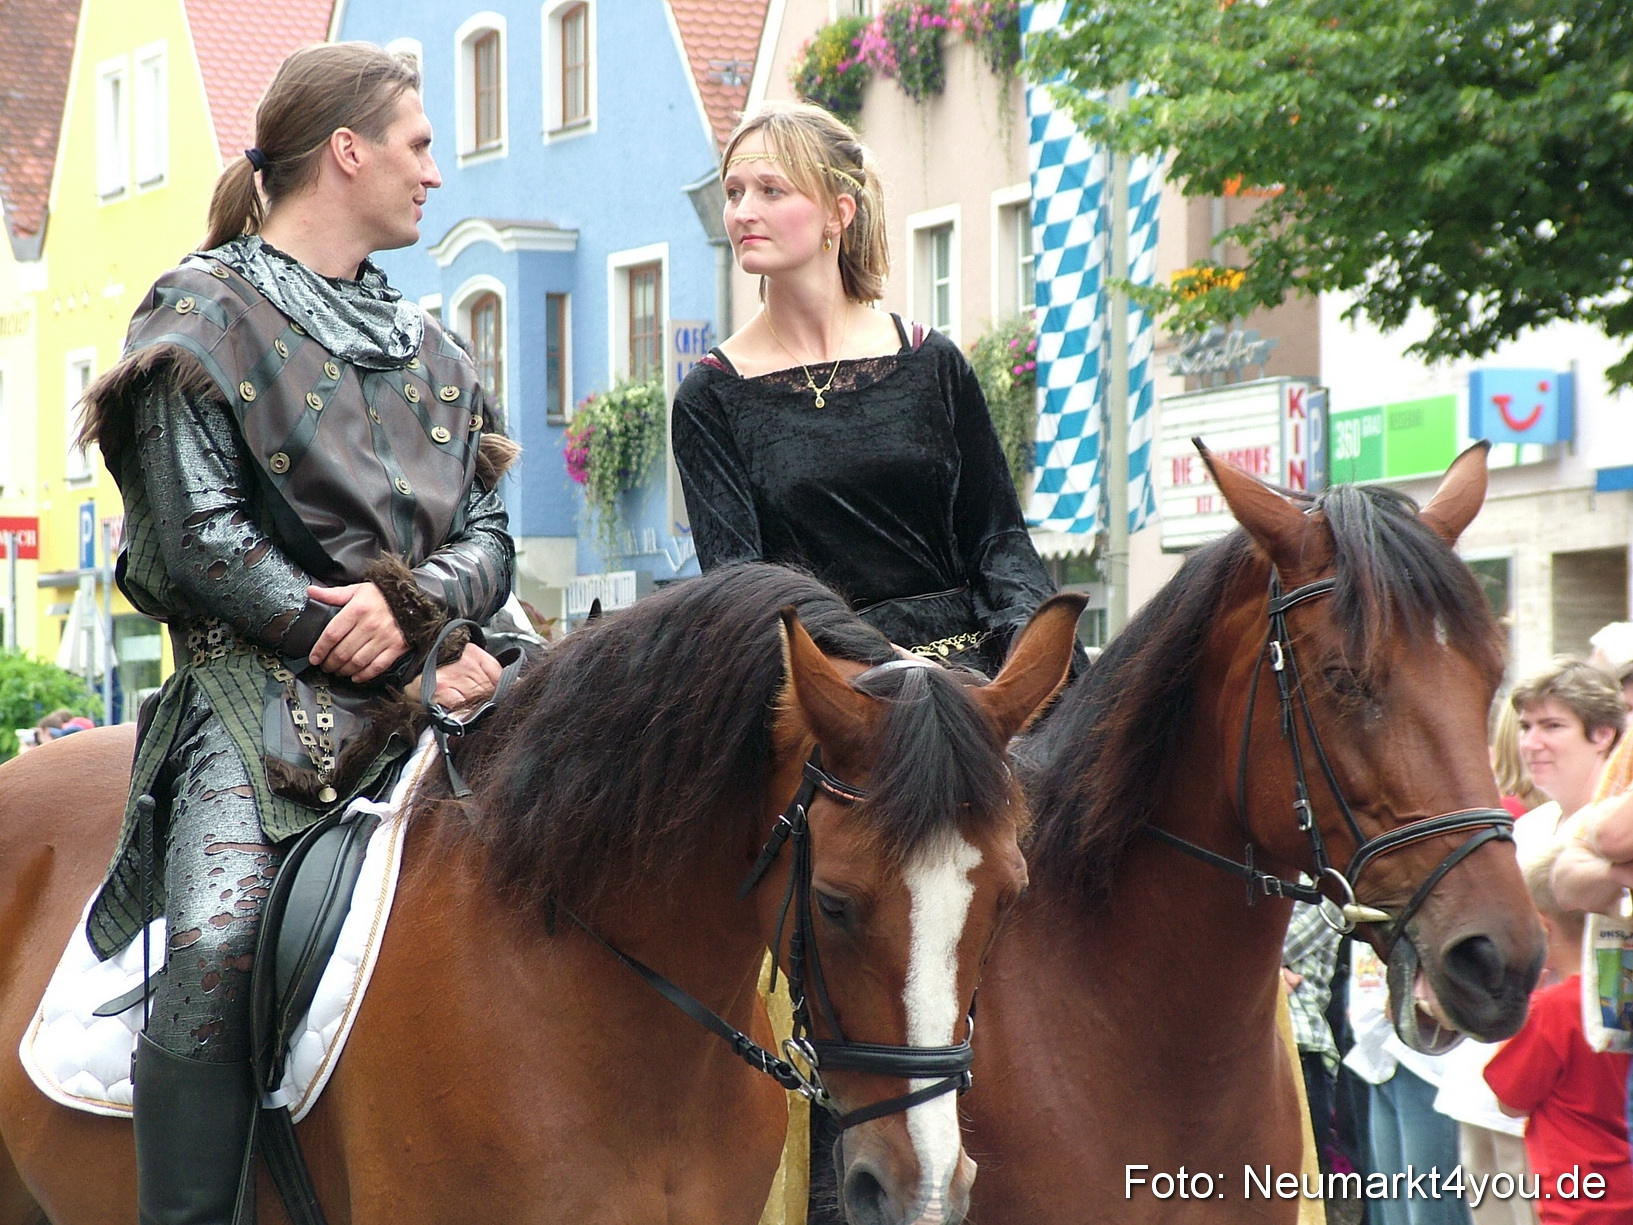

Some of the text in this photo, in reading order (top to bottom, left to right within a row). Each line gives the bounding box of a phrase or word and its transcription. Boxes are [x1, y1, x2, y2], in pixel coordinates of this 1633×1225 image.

[675, 322, 710, 356] CAFÉ
[1334, 418, 1361, 460] 360
[81, 510, 93, 563] P
